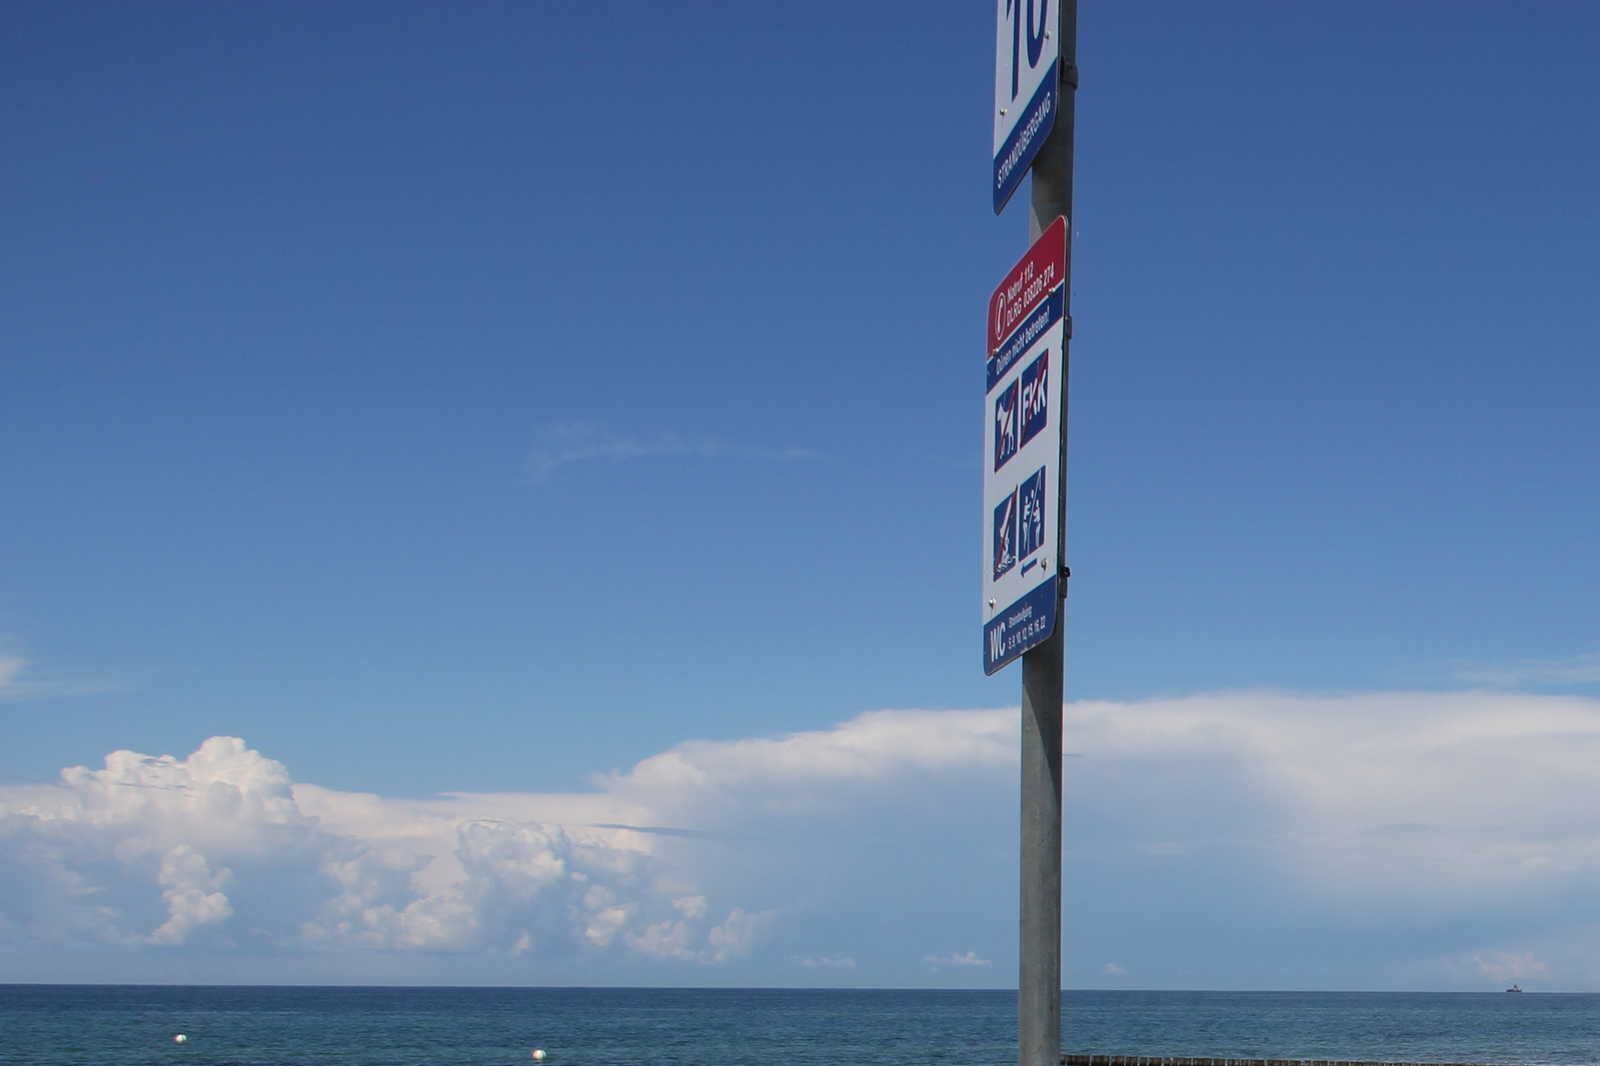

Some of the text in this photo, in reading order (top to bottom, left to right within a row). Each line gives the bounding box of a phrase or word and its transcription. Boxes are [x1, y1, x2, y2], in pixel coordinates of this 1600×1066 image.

[1025, 261, 1034, 284] 112
[1006, 297, 1022, 327] DLRG
[1022, 368, 1046, 427] FKK
[990, 621, 1006, 662] WC
